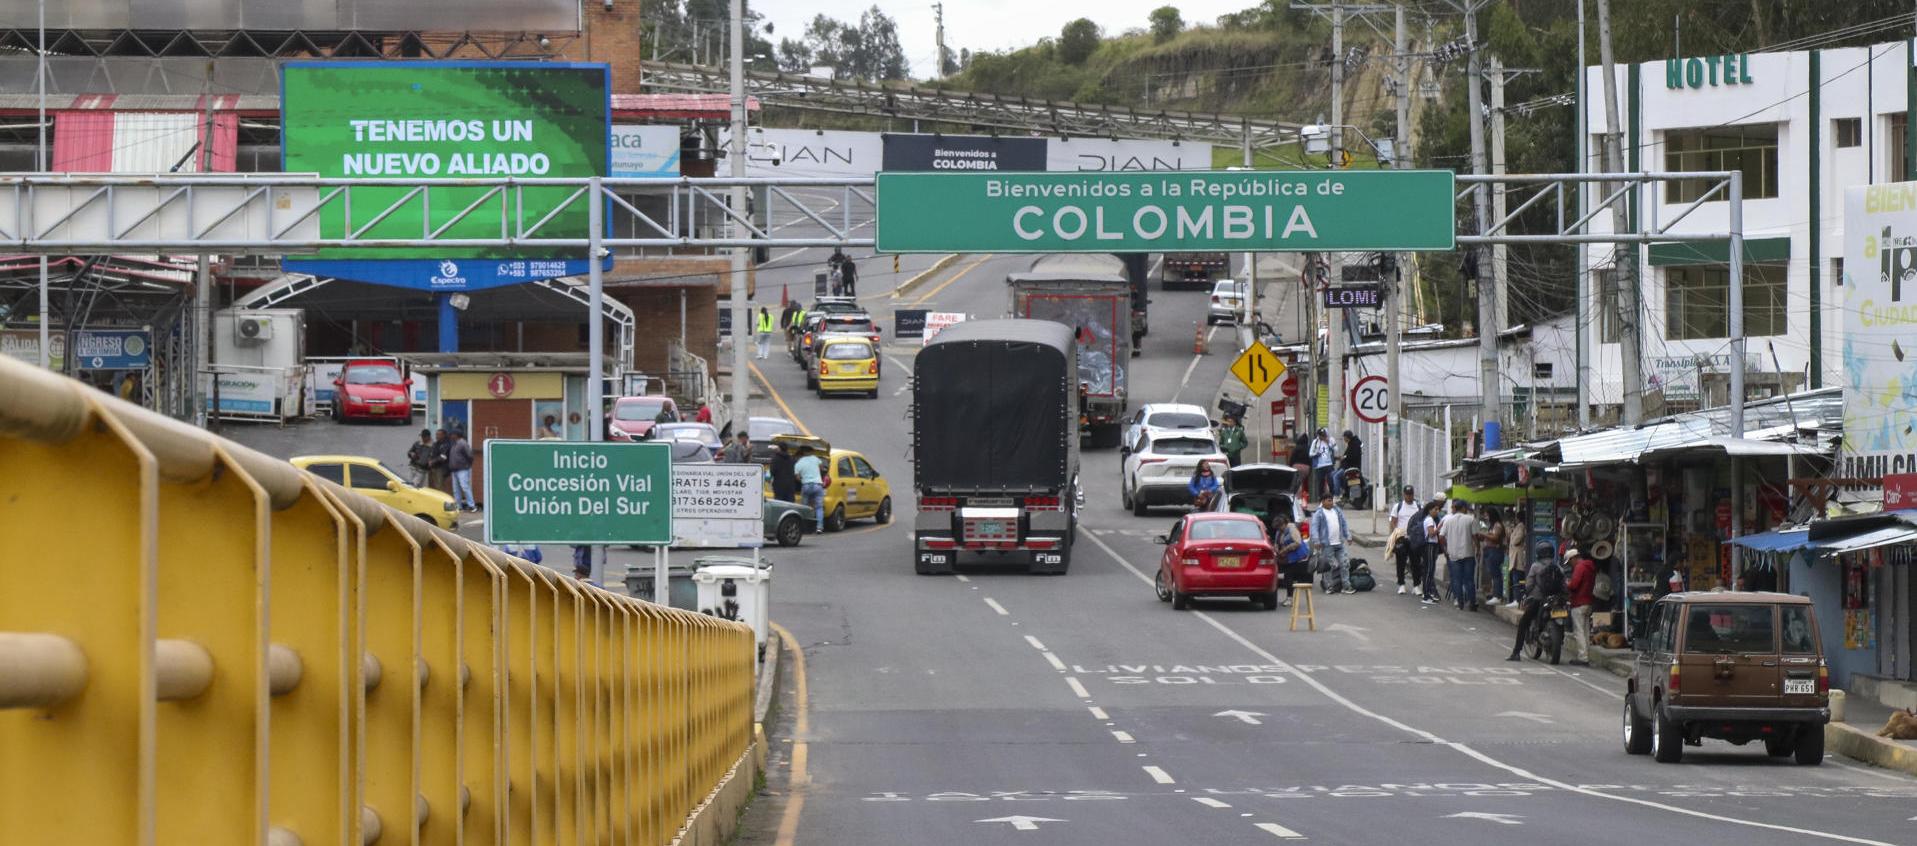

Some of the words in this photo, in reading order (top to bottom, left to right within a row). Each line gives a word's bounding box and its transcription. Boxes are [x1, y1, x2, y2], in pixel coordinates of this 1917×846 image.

[1666, 53, 1753, 89] HOTEL
[350, 120, 485, 142] TENEMOS
[492, 120, 533, 142] UN
[934, 148, 990, 158] Bienvenidos
[343, 153, 441, 175] NUEVO
[447, 153, 550, 175] ALIADO
[933, 159, 998, 170] COLOMBIA
[1078, 155, 1181, 171] DIAN
[986, 180, 1132, 197] Bienvenidos
[1140, 184, 1153, 197] a
[1162, 180, 1182, 196] la
[1191, 178, 1308, 200] República
[1317, 179, 1345, 196] de
[1013, 204, 1318, 240] COLOMBIA
[430, 276, 466, 284] Espectro
[1361, 388, 1388, 411] 20
[553, 450, 608, 469] Inicio
[508, 473, 610, 492] Concesión
[616, 473, 652, 492] Vial
[716, 478, 747, 488] #446
[514, 495, 572, 515] Unión
[579, 497, 609, 515] Del
[616, 497, 650, 516] Sur
[1107, 675, 1288, 684] SOLO
